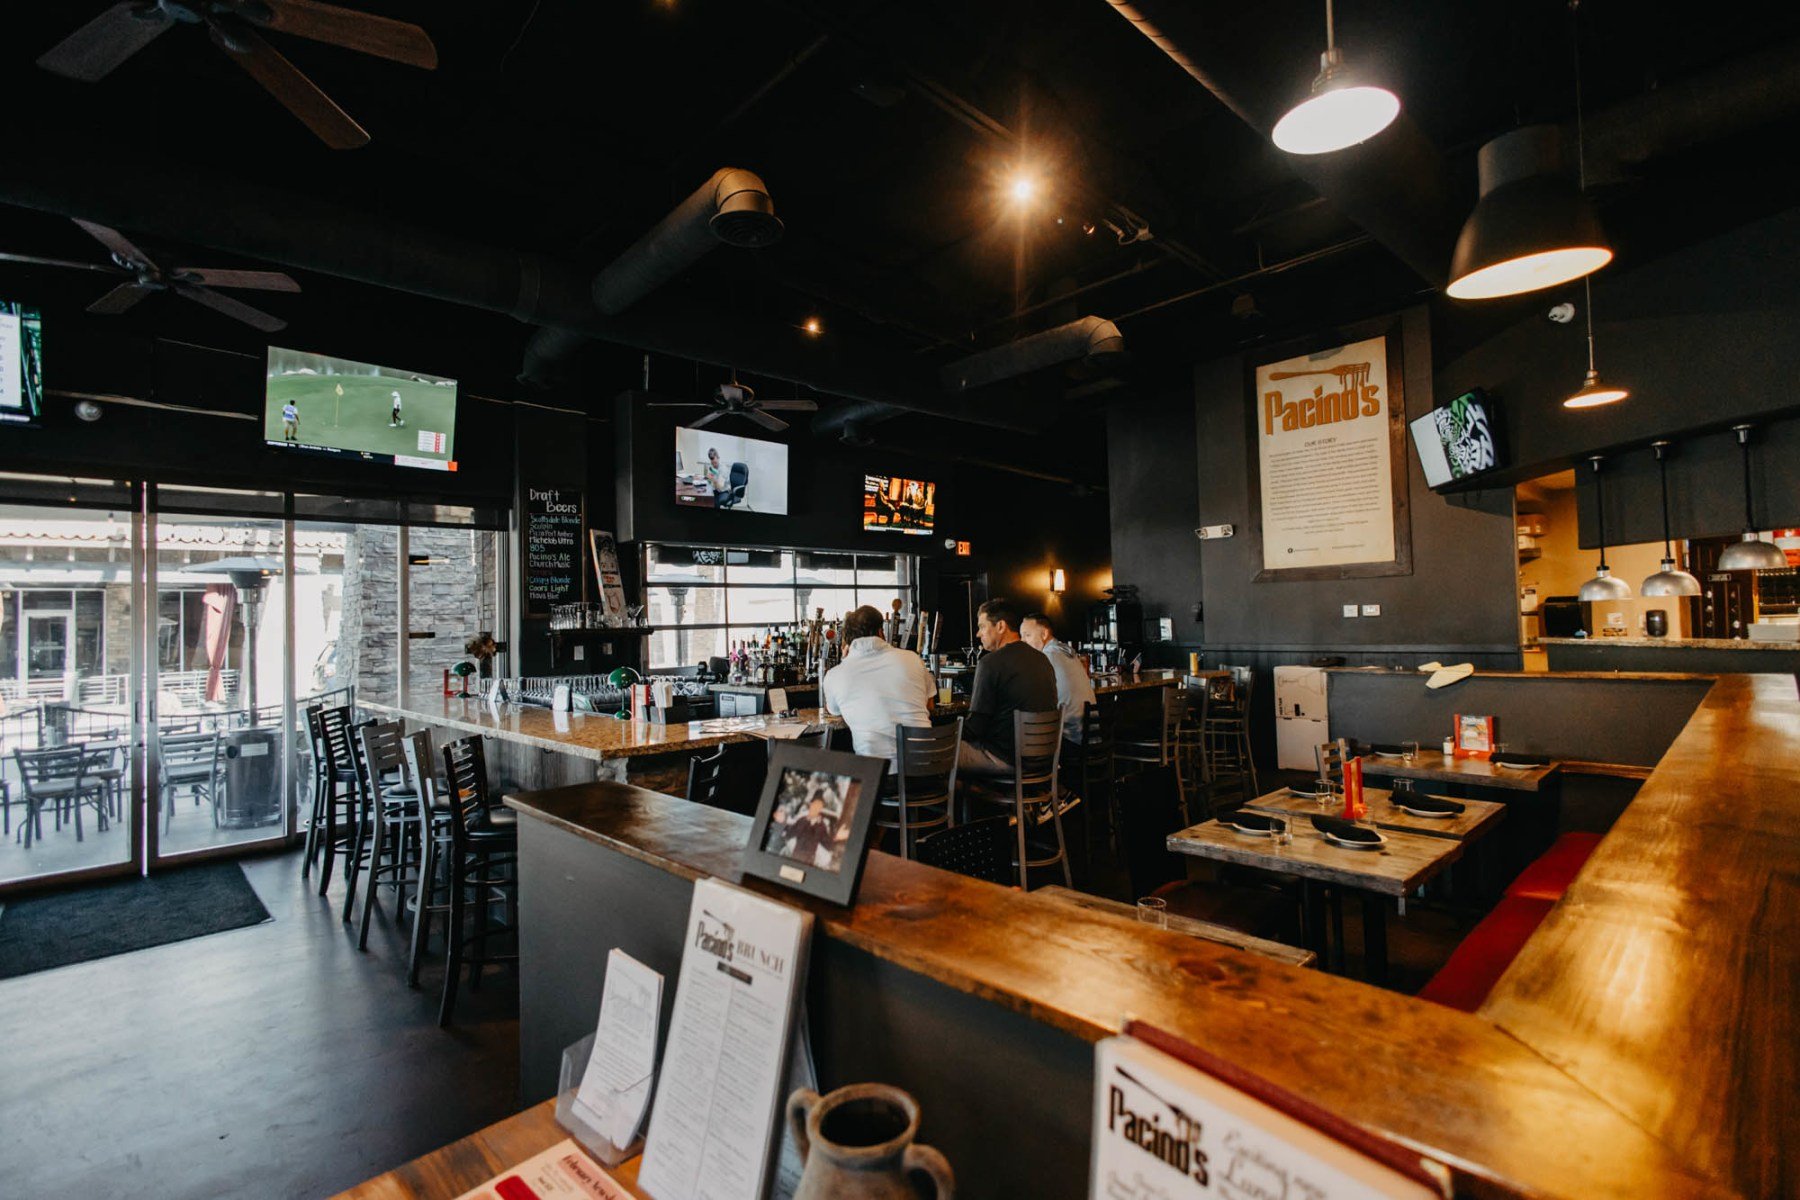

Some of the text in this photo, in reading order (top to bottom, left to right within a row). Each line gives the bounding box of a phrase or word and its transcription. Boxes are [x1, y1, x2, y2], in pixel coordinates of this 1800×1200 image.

[1264, 384, 1381, 435] Pacino's
[529, 488, 560, 501] Draft
[546, 501, 577, 514] Beers
[560, 515, 581, 524] Blonde
[529, 537, 575, 546] Michelob Ultra
[958, 542, 970, 555] EXIT
[559, 552, 571, 561] Ale
[550, 584, 569, 593] Light
[737, 940, 785, 974] BRUNCH
[1109, 1084, 1208, 1187] Pacino's
